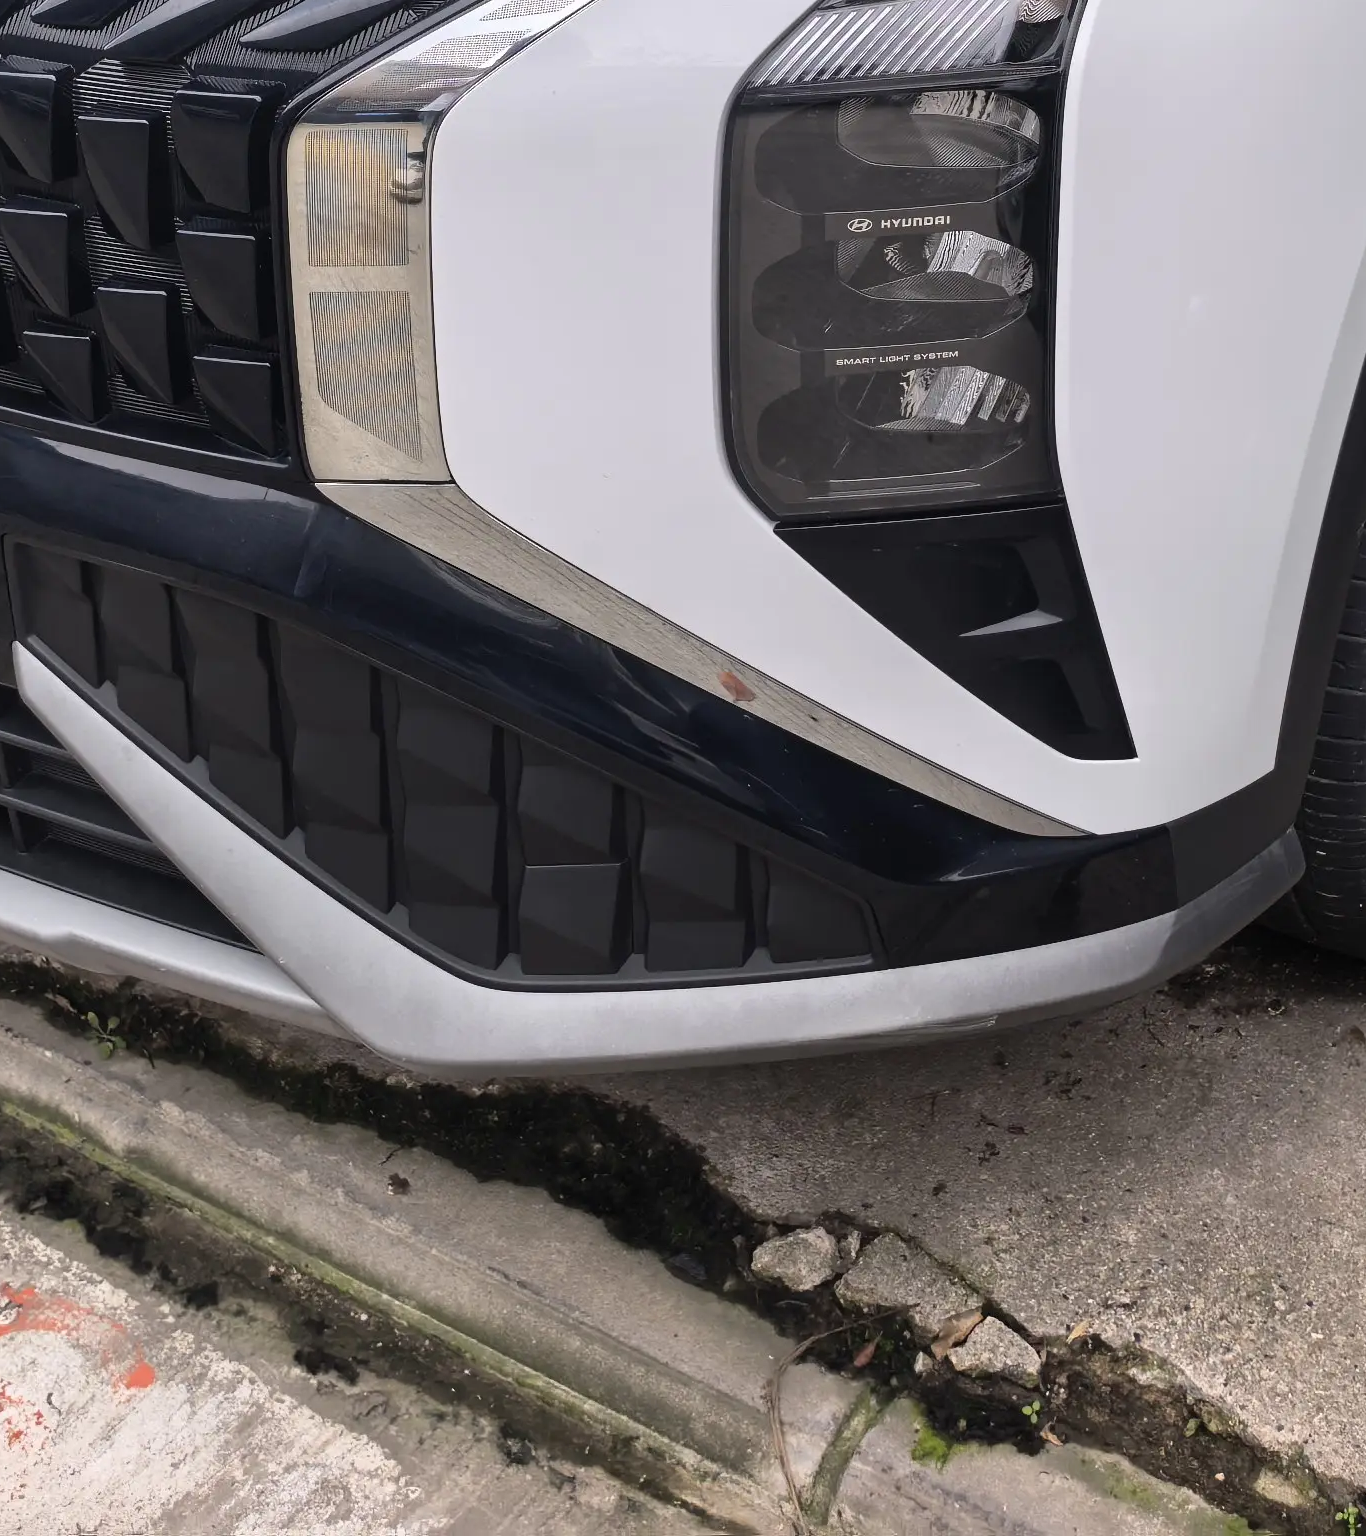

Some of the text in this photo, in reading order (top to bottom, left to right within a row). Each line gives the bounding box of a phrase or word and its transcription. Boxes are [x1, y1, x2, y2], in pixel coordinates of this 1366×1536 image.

[880, 215, 952, 229] HYUNDAI
[836, 350, 959, 366] SMART LIGHT SYSTEM
